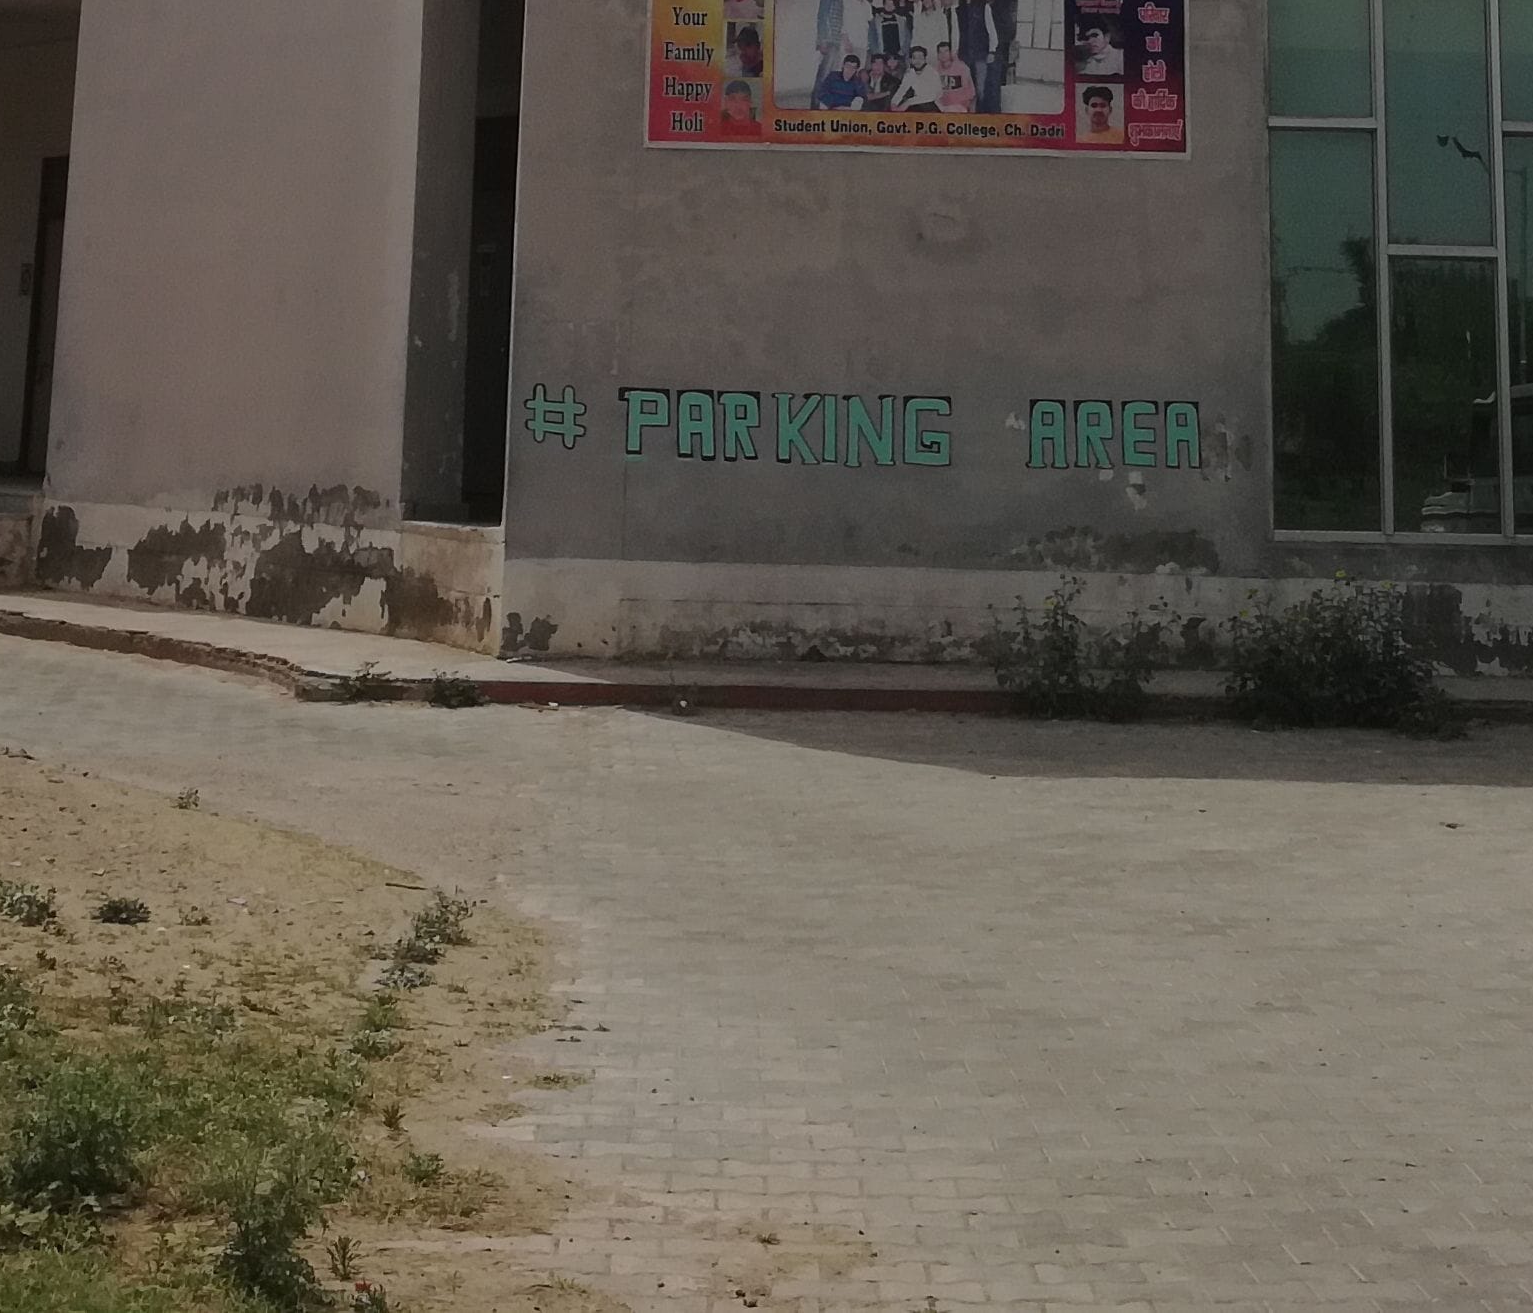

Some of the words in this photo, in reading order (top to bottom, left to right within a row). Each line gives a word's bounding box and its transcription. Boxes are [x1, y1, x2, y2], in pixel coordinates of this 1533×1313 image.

[672, 6, 707, 26] Your
[664, 41, 714, 66] Family
[664, 77, 712, 101] Happy
[671, 112, 704, 132] Holi
[774, 119, 826, 133] Student
[830, 120, 872, 135] Union,
[876, 121, 911, 134] Govt.
[915, 121, 942, 135] P.G.
[946, 122, 1000, 138] College,
[1004, 123, 1026, 136] Ch.
[1030, 124, 1065, 137] Dadri
[619, 387, 952, 468] PARKING
[1026, 399, 1201, 469] AREA
